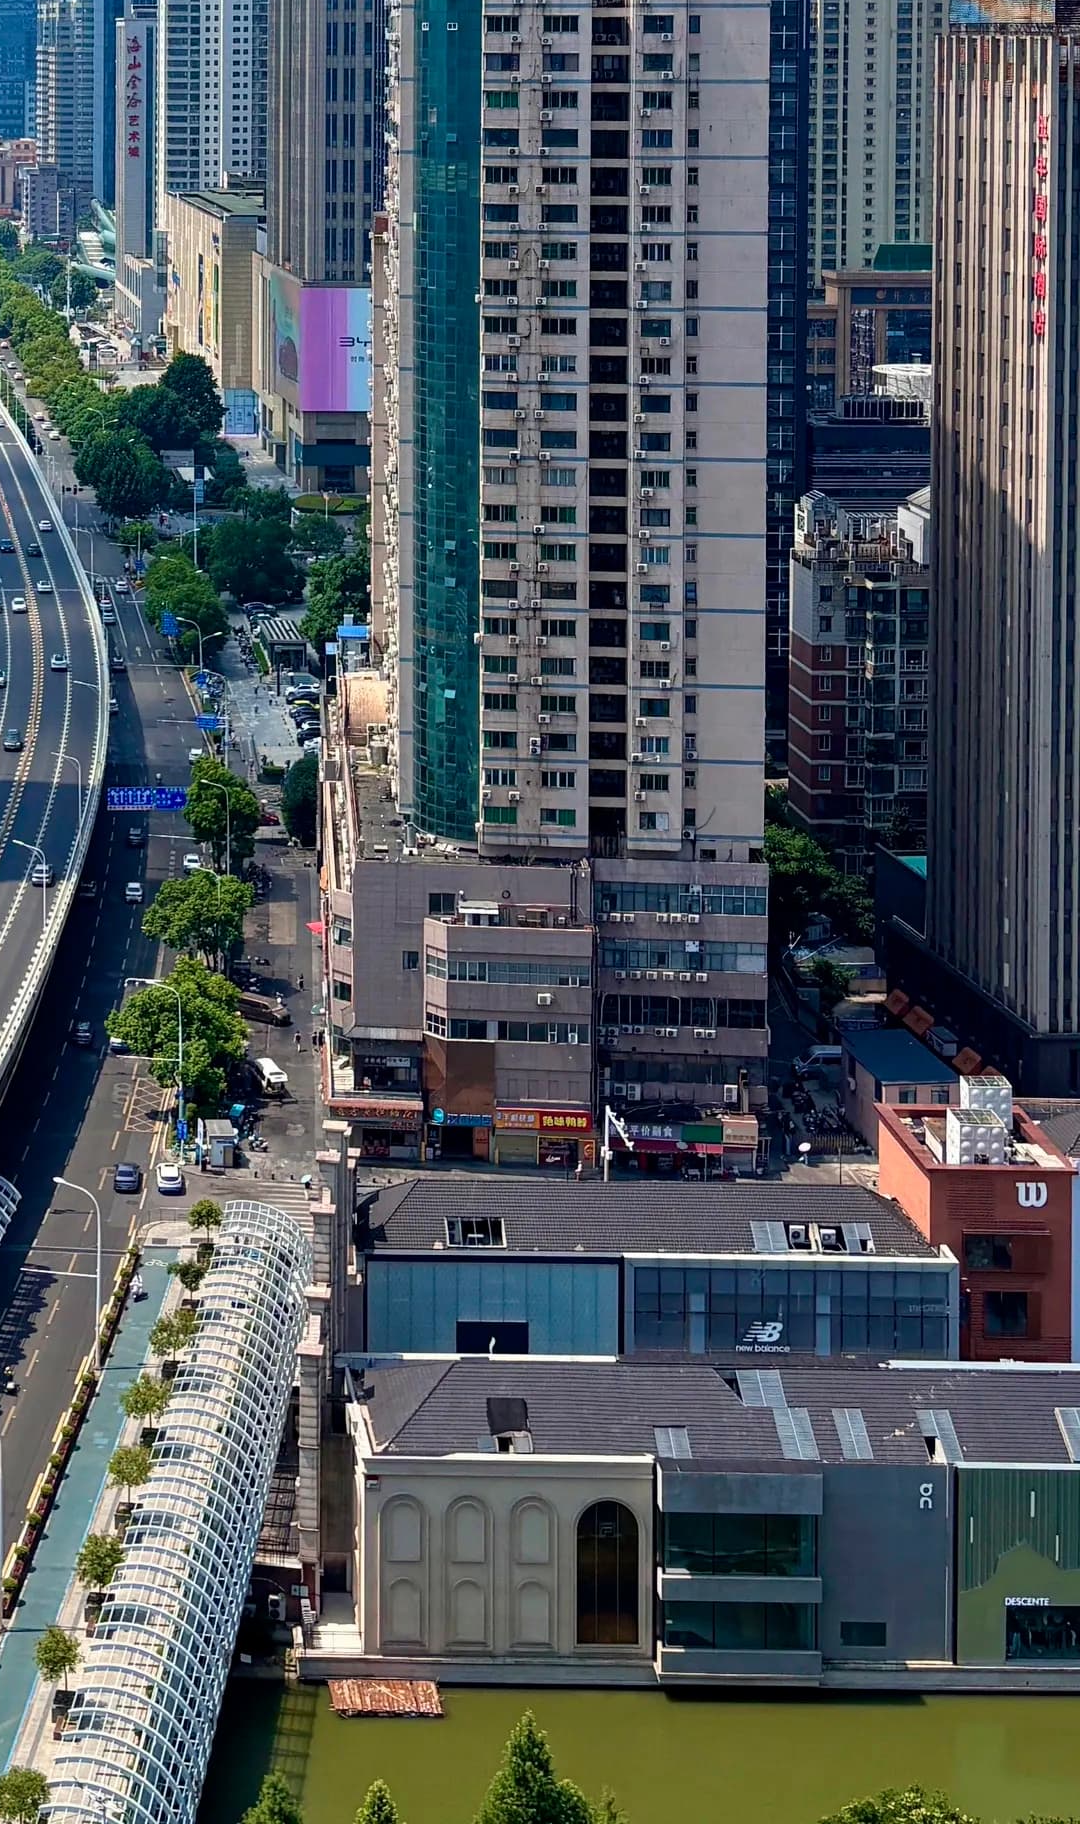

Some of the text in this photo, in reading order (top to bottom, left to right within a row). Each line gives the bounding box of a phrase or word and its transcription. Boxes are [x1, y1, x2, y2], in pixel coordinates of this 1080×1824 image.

[735, 1344, 791, 1353] new balance
[1005, 1597, 1050, 1606] DESCENTE
